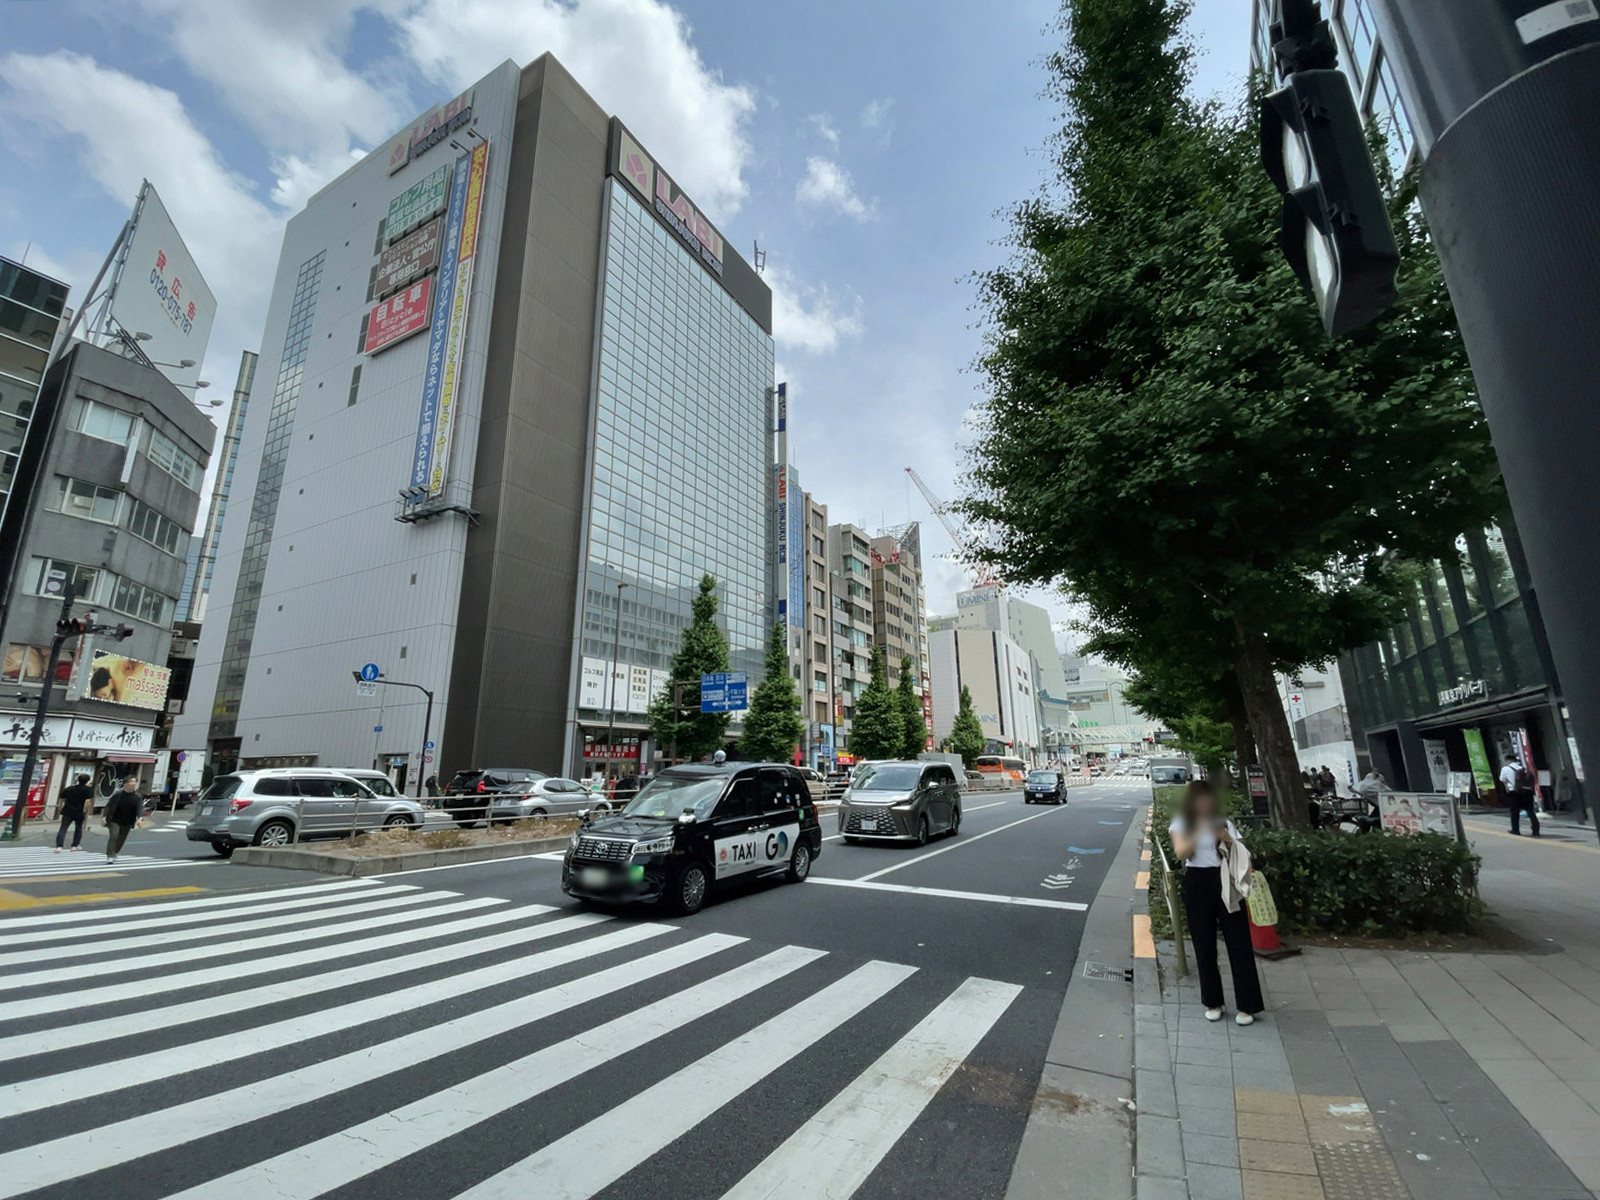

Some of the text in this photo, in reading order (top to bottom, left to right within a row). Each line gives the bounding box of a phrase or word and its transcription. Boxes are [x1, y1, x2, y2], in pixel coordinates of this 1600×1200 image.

[656, 170, 720, 260] LABI
[376, 284, 423, 322] 自転車
[126, 678, 166, 699] massage
[732, 841, 757, 861] TAXI
